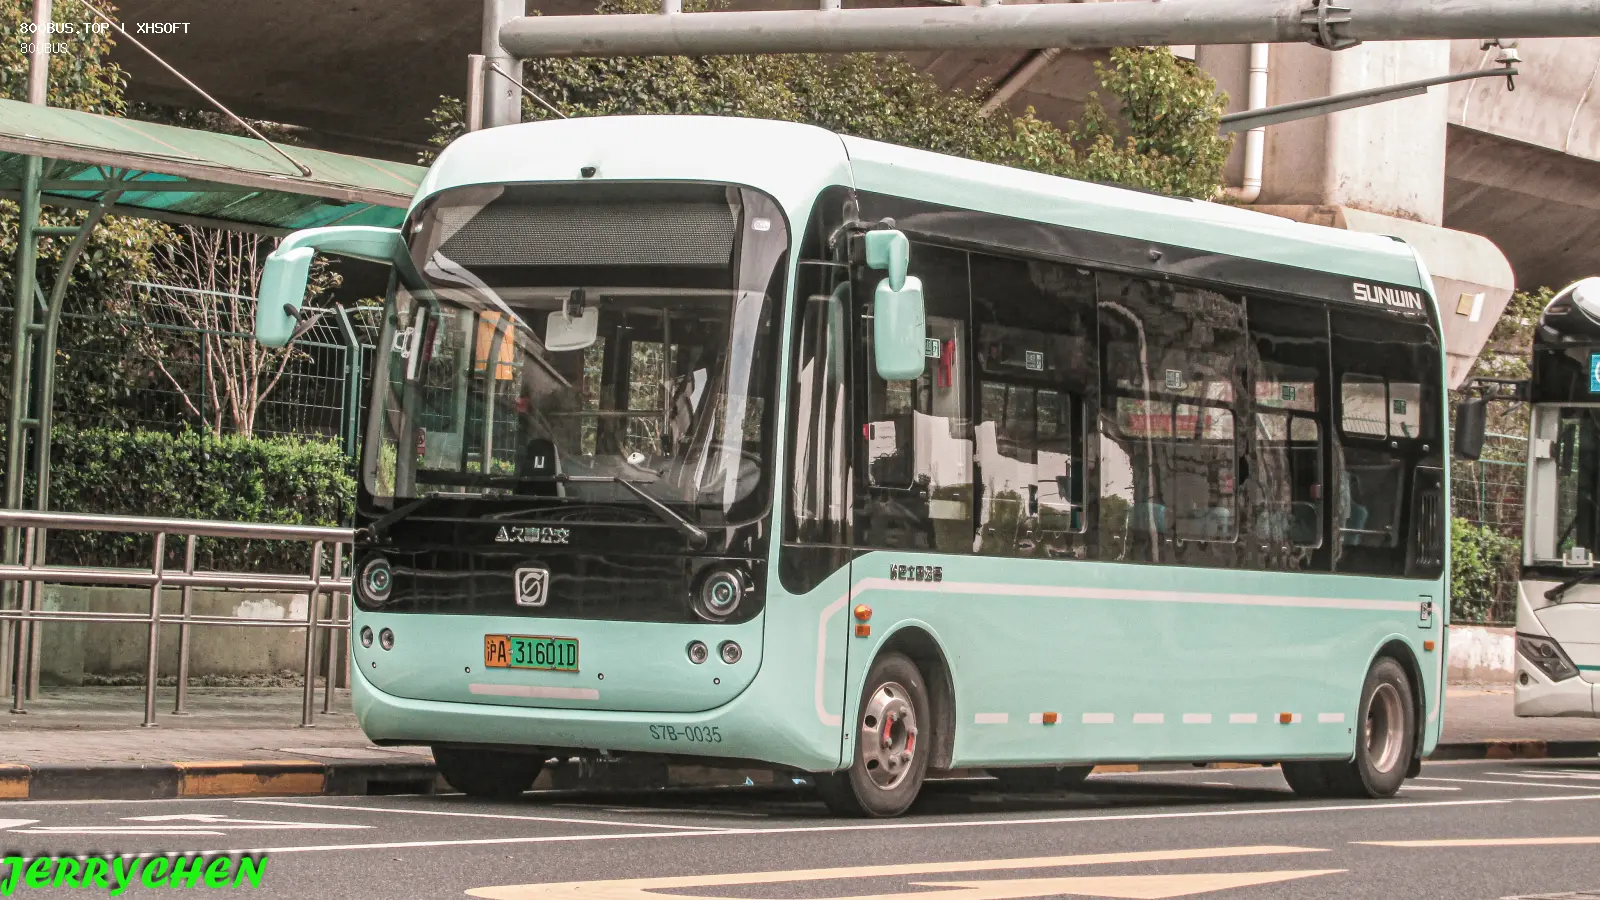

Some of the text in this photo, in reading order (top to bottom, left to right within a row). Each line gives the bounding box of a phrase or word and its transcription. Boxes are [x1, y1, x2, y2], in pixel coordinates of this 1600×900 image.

[1353, 282, 1422, 310] SUNWIN
[515, 641, 576, 666] 31601D
[649, 724, 722, 743] S7B-0035
